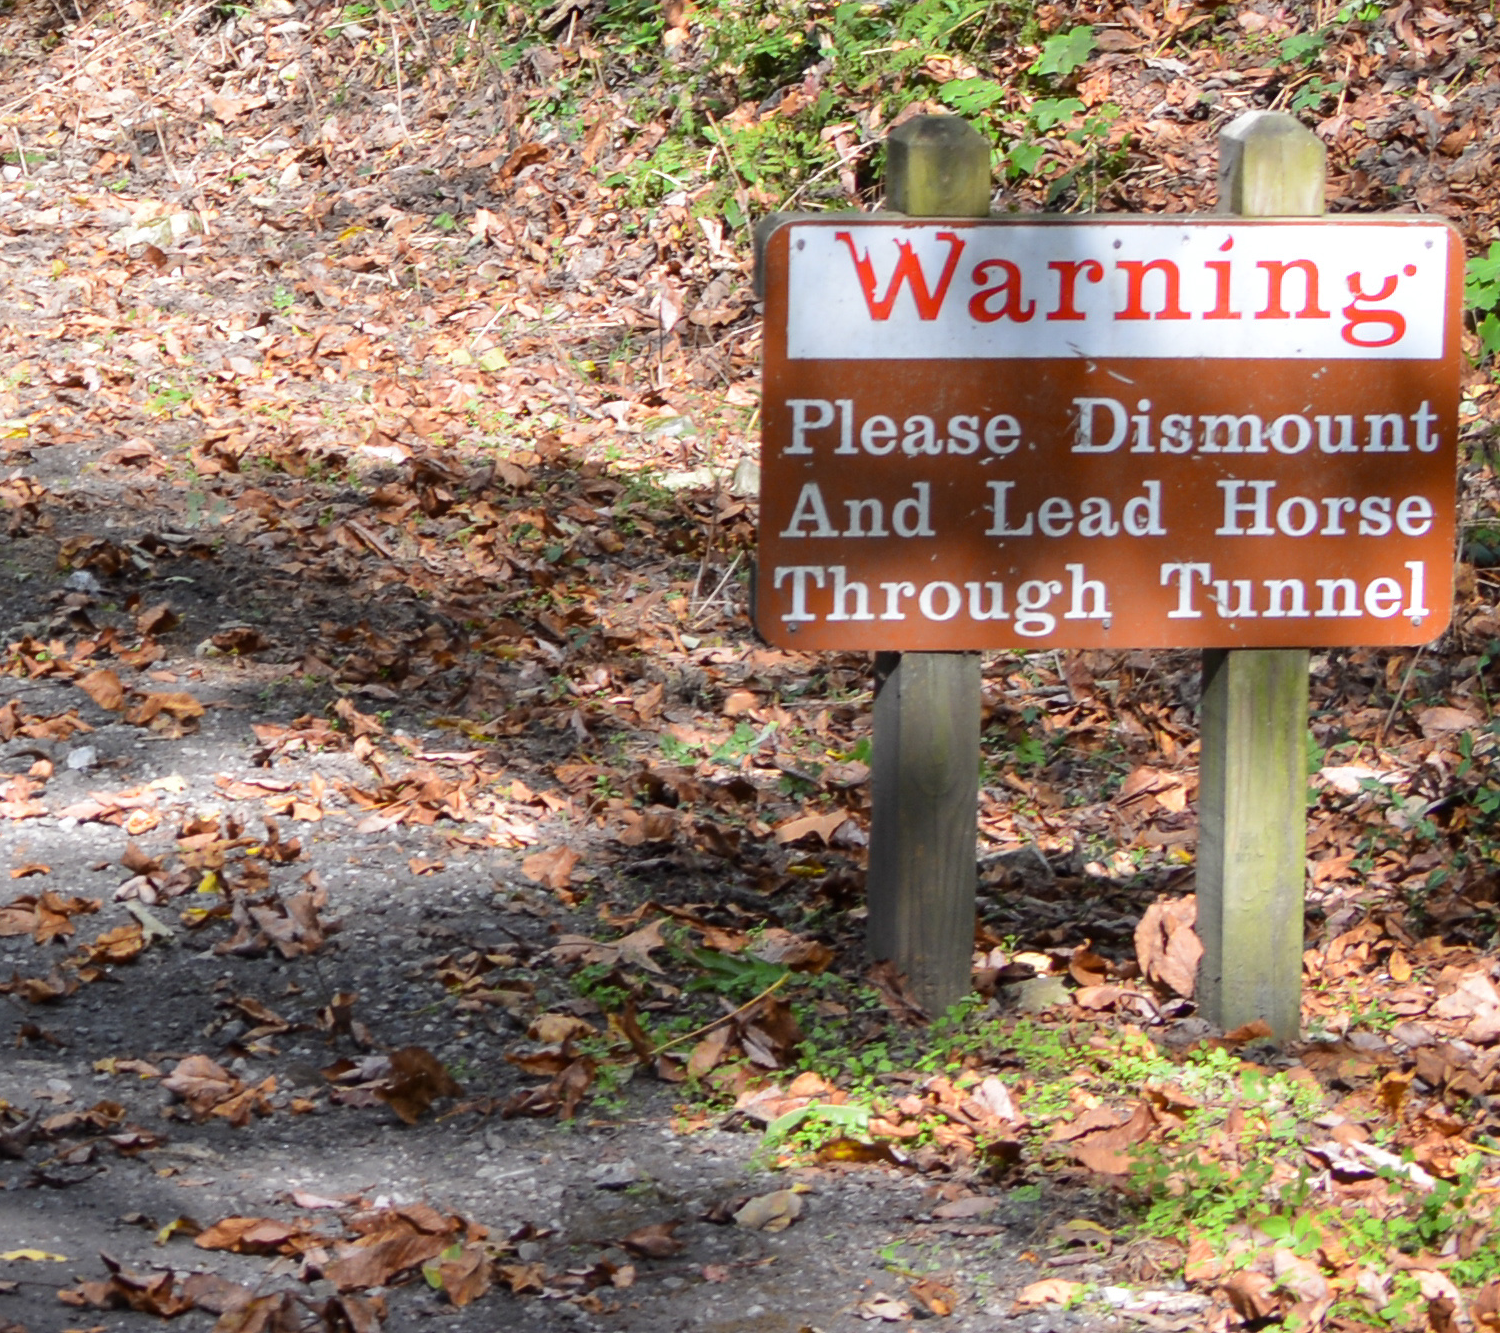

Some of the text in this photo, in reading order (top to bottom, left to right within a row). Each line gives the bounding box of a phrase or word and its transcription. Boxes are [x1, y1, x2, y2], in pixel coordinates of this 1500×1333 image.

[834, 231, 1418, 348] Warning
[782, 396, 1440, 457] Please Dismount
[778, 479, 1433, 538] And Lead Horse
[773, 561, 1430, 638] Through Tunnel
